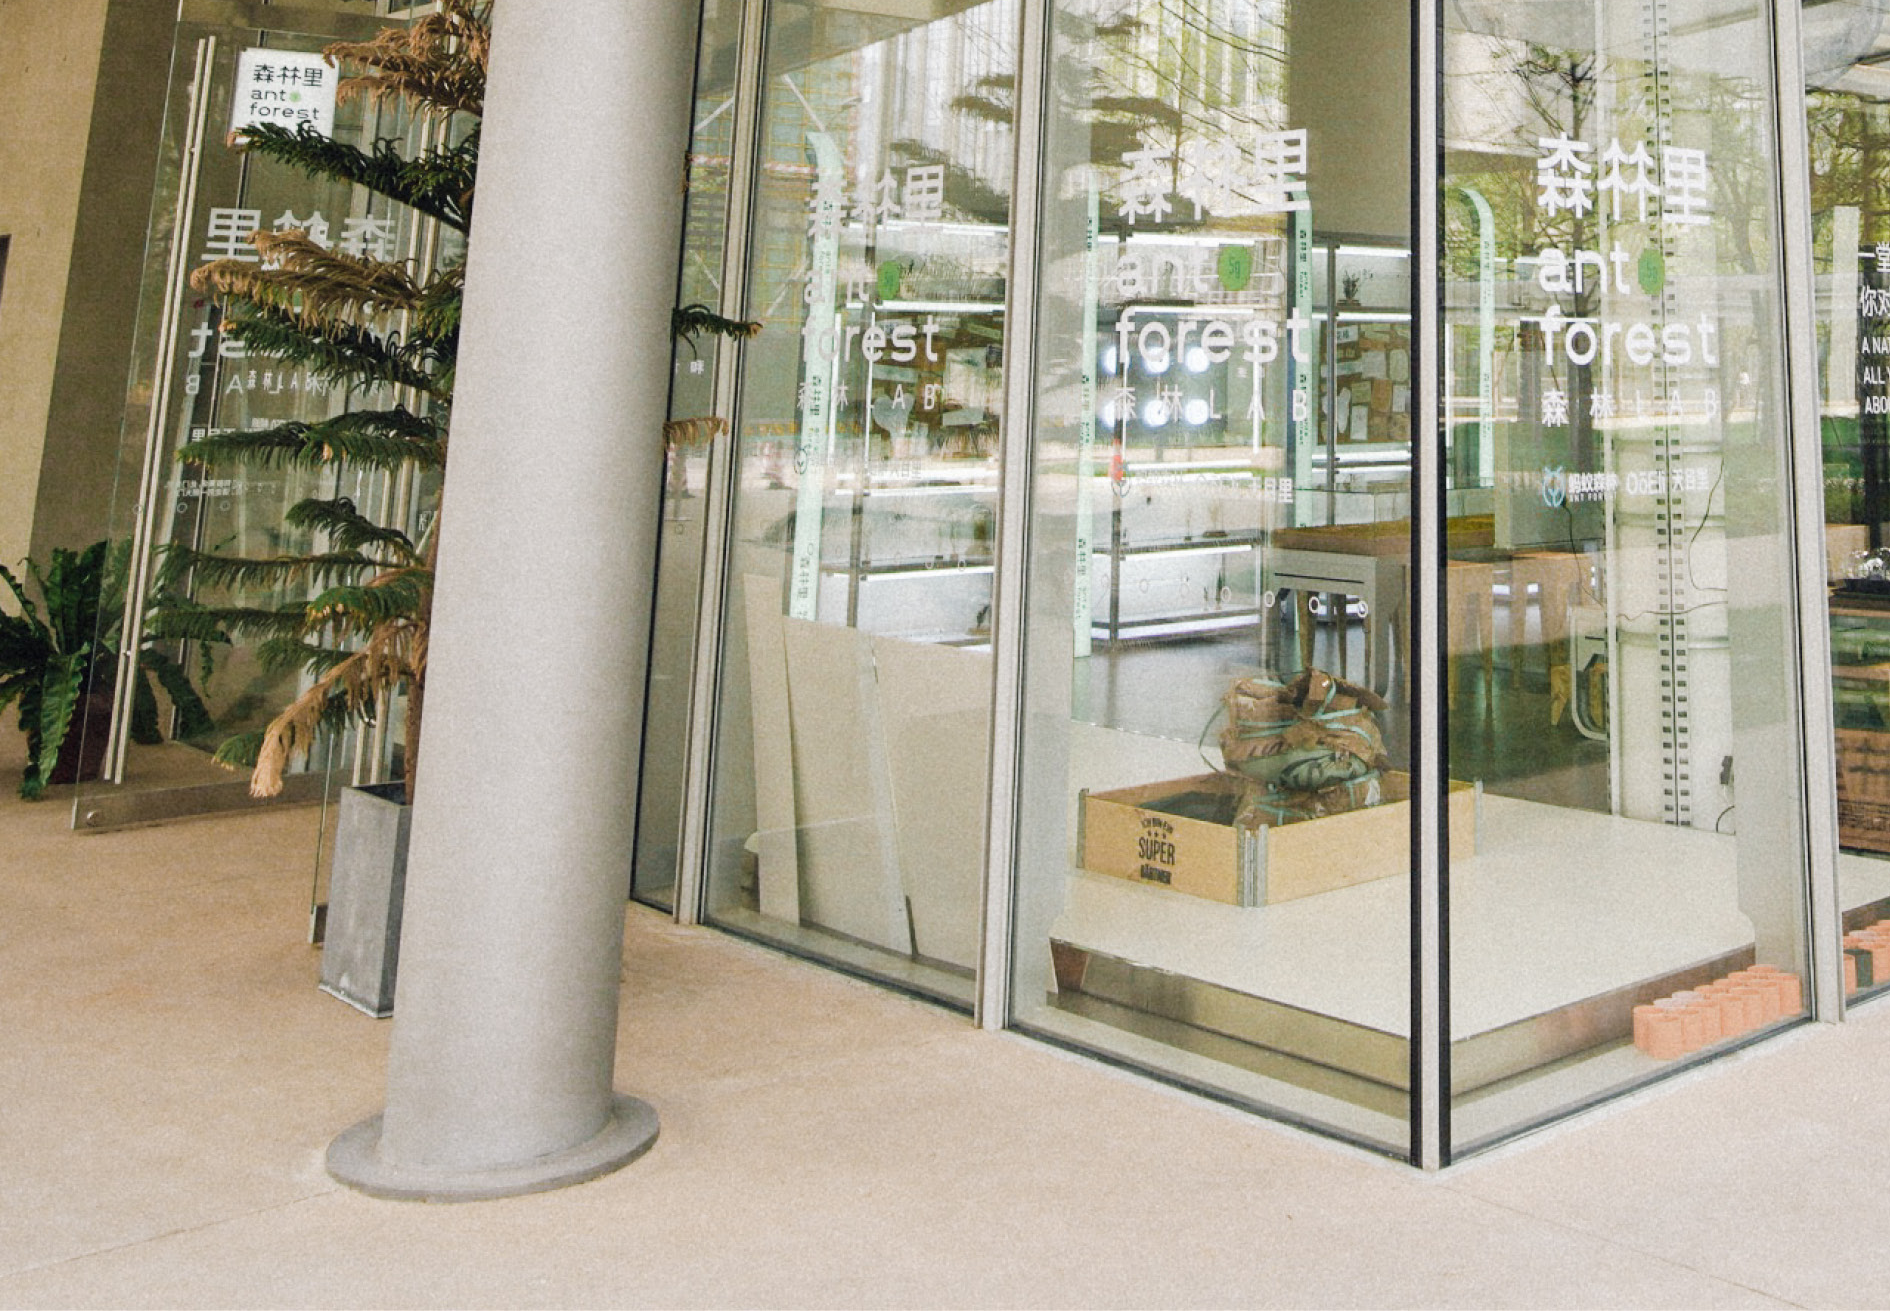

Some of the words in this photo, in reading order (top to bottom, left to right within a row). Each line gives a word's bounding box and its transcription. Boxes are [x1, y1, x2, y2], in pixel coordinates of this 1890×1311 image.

[253, 63, 323, 87] 森林里
[250, 89, 287, 102] ant
[249, 102, 320, 121] forest
[1537, 131, 1711, 226] 森林里
[1538, 240, 1631, 295] ant
[801, 314, 941, 364] forest
[1115, 305, 1311, 364] forest
[1540, 304, 1719, 368] forest
[1861, 337, 1871, 353] A
[1863, 365, 1886, 384] ALL
[1138, 836, 1176, 866] SUPER
